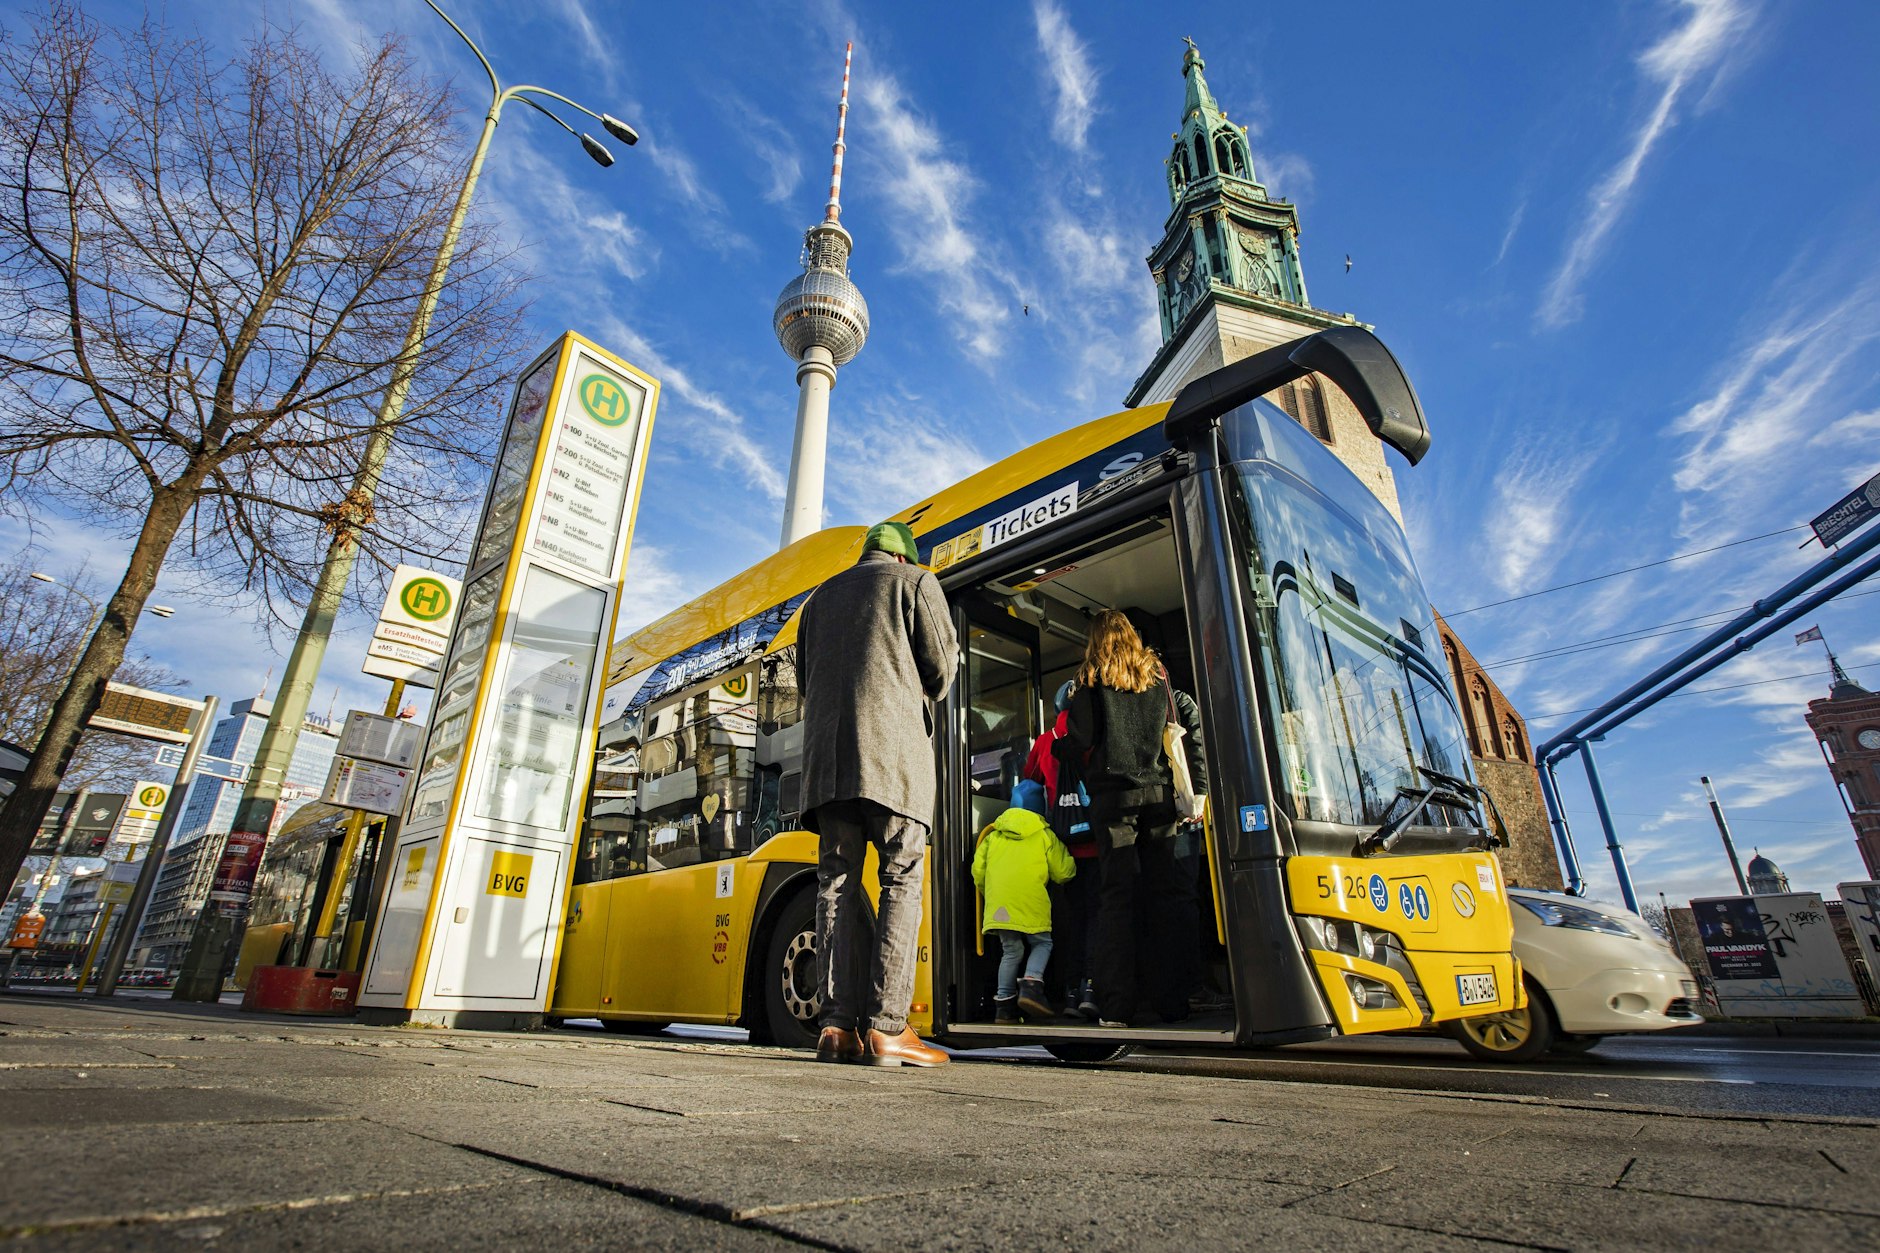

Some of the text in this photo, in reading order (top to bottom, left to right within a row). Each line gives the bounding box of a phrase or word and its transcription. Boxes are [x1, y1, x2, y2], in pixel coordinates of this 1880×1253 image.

[570, 425, 582, 436] 100
[563, 448, 578, 459] 200
[593, 444, 618, 460] Reichstag
[611, 447, 629, 458] Garten
[559, 469, 570, 480] N2
[605, 468, 623, 479] Garten
[575, 477, 591, 488] U-Bhf
[1098, 470, 1143, 494] SOLARIS
[553, 492, 564, 502] N5
[574, 483, 599, 499] Ruhleben
[570, 499, 593, 513] S+U-Bhf
[547, 516, 559, 526] N8
[568, 506, 607, 527] Hauptbahnhof
[989, 493, 1071, 544] Tickets
[1815, 496, 1867, 533] BRECHTEL
[565, 523, 588, 537] S+U-Bhf
[541, 540, 558, 552] N40
[563, 530, 605, 550] Hermannstraße
[559, 547, 588, 562] Karlshorst
[383, 627, 443, 648] Ersatzhaltestelle
[666, 664, 687, 691] 200
[493, 873, 526, 893] BVG
[715, 913, 730, 927] BVG
[713, 942, 728, 953] VBB
[1745, 943, 1767, 951] DYK
[1477, 977, 1495, 999] 5426
